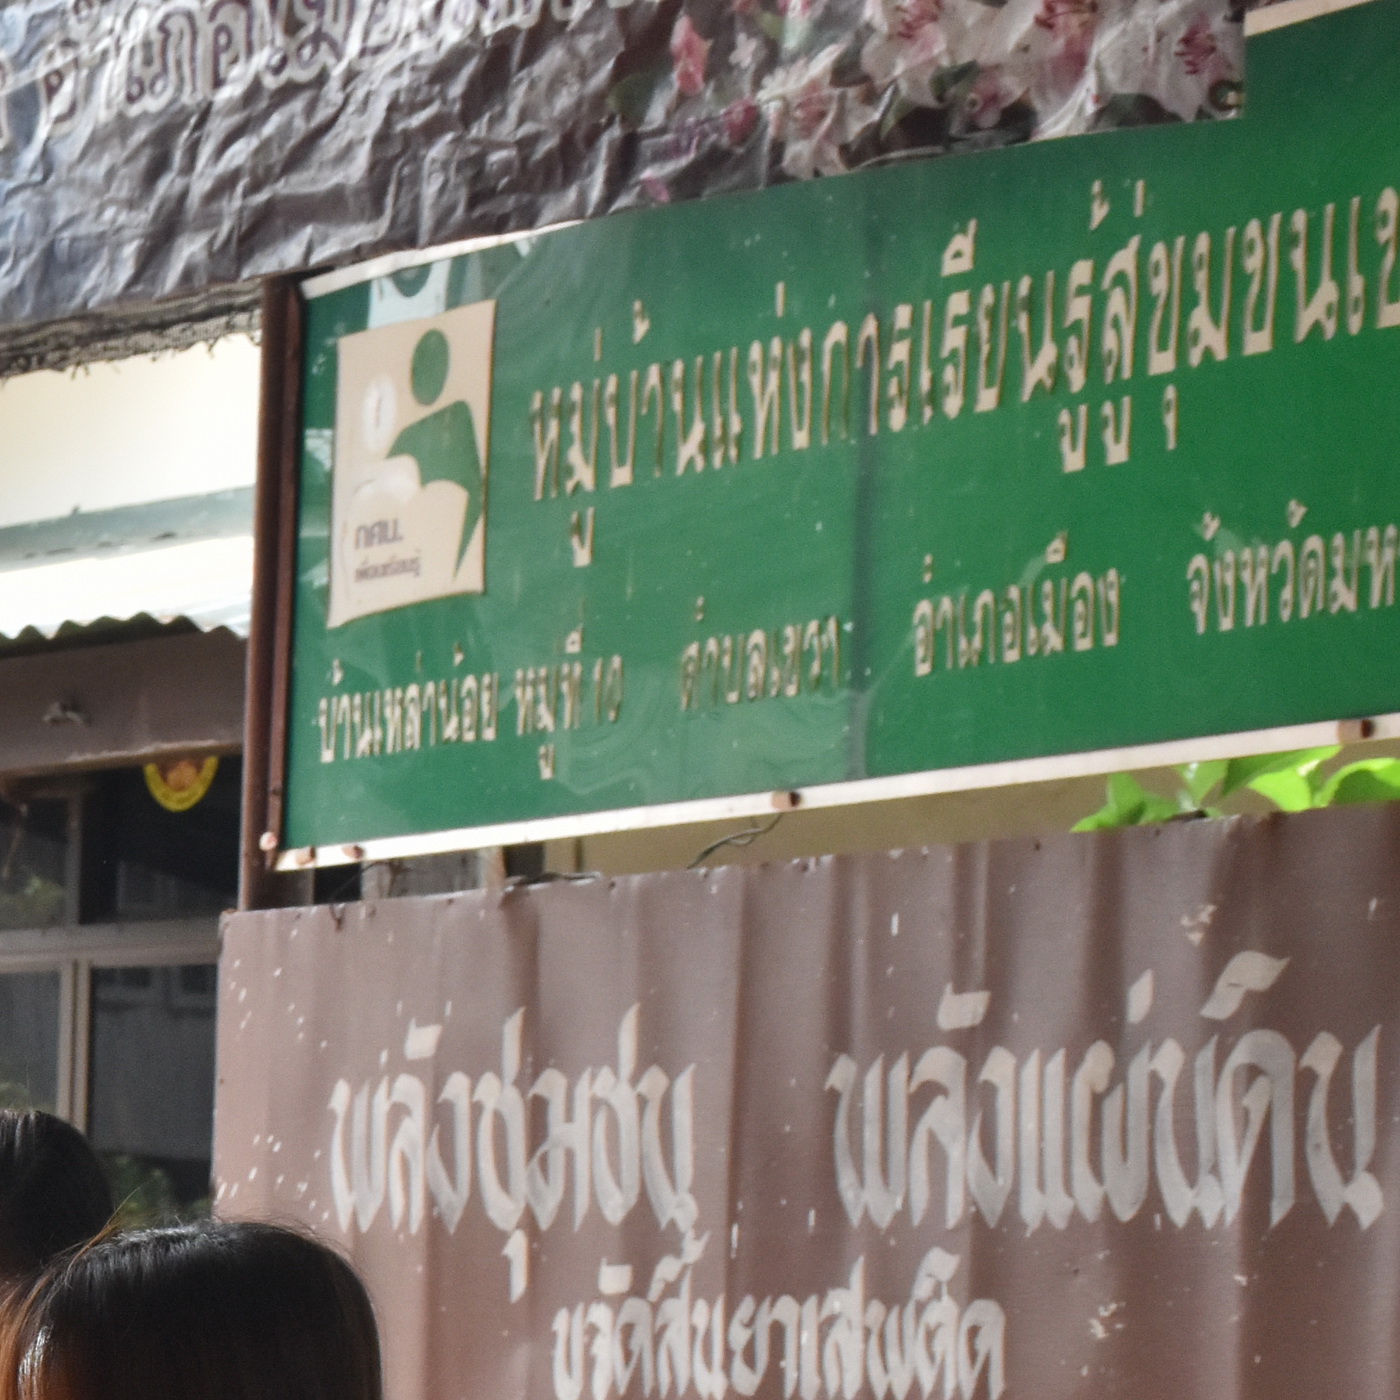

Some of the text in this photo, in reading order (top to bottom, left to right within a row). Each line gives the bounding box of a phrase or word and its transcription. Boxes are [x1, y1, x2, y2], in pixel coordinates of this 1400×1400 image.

[912, 529, 1122, 677] อำเภอเมือง
[328, 950, 1385, 1303] พลังชุมชน พลังแผ่นดิน
